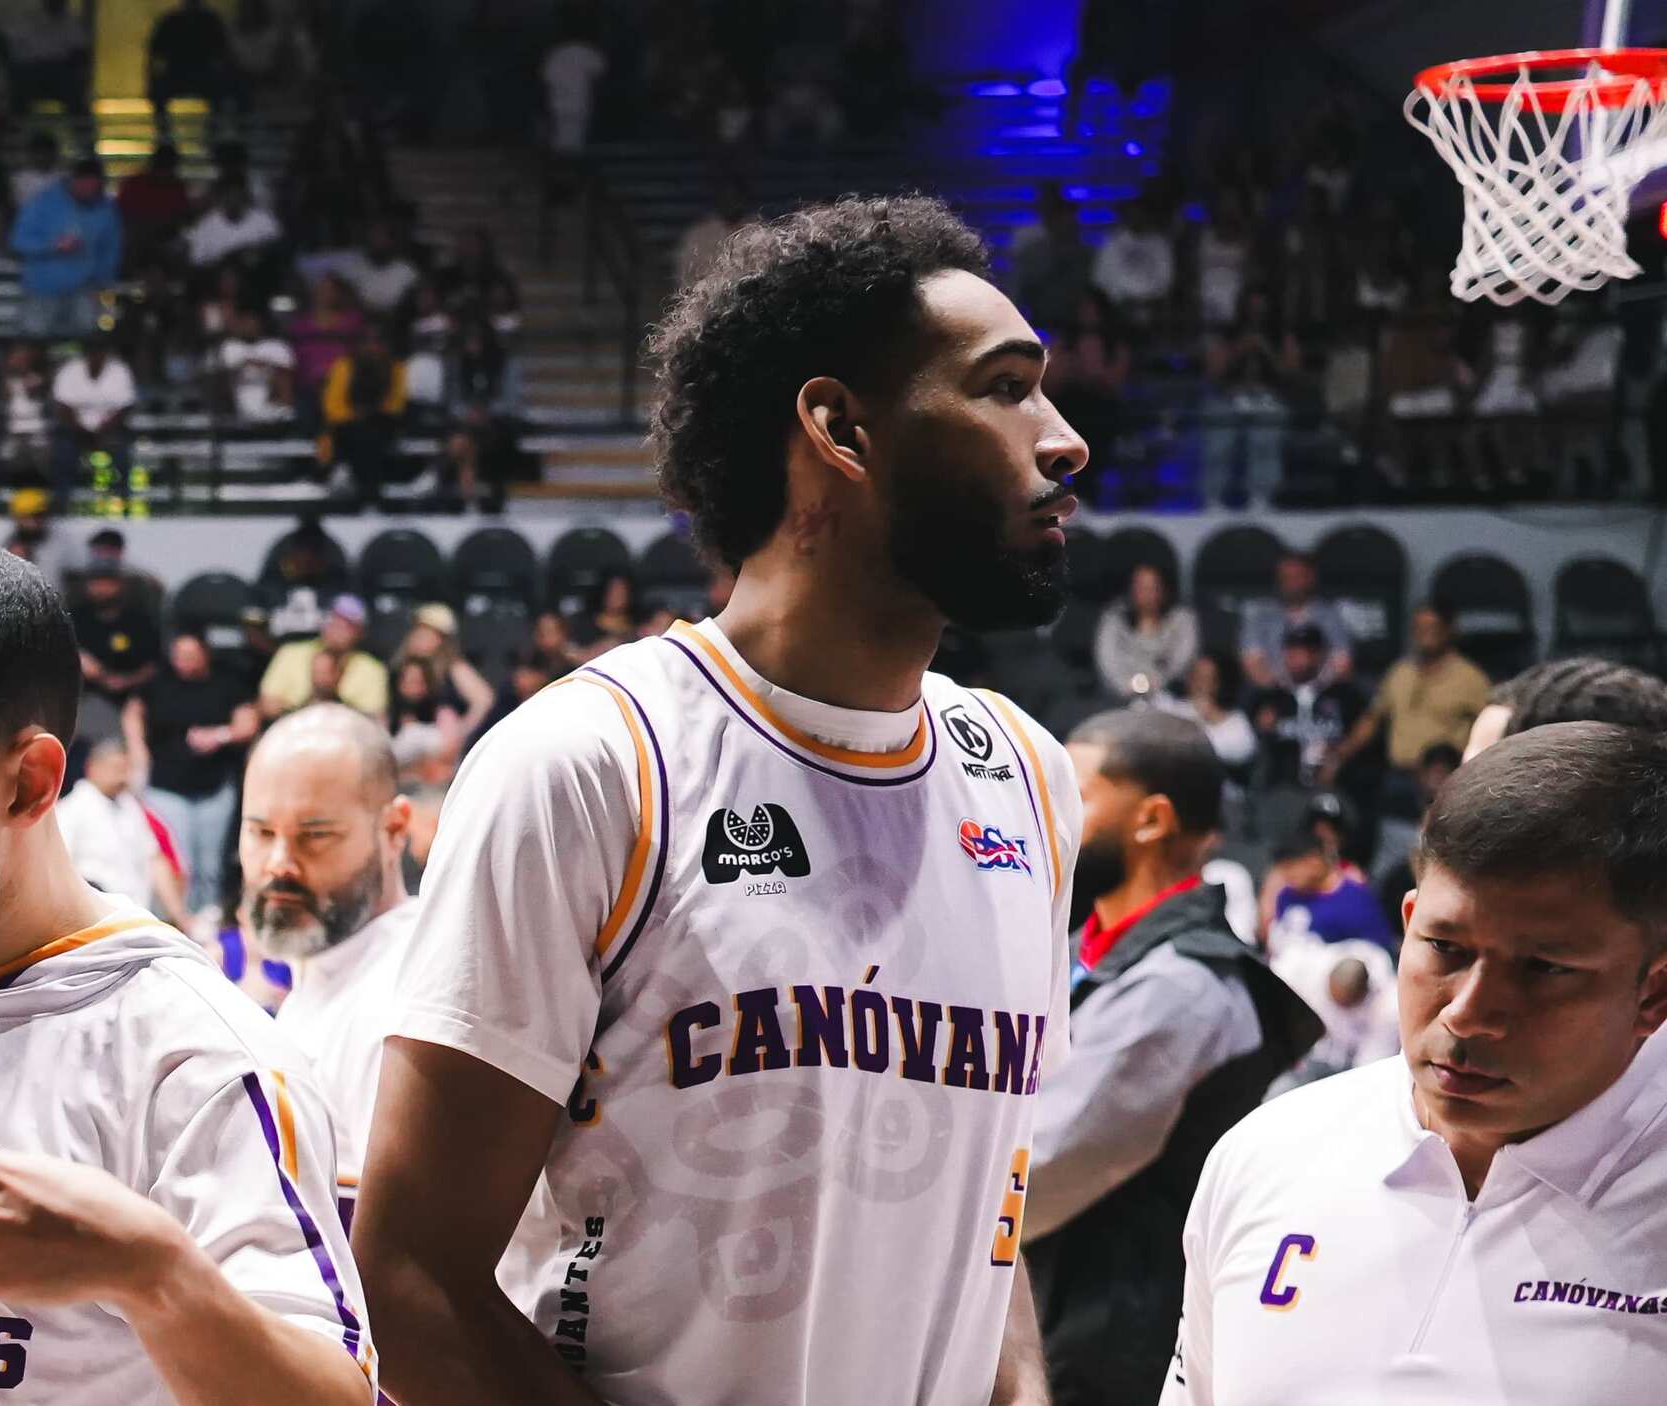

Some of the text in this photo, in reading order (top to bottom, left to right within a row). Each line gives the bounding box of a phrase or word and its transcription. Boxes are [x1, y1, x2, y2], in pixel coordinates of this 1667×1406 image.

[718, 846, 793, 866] MARCO'S
[745, 880, 787, 897] PIZZA
[1259, 1233, 1318, 1312] C
